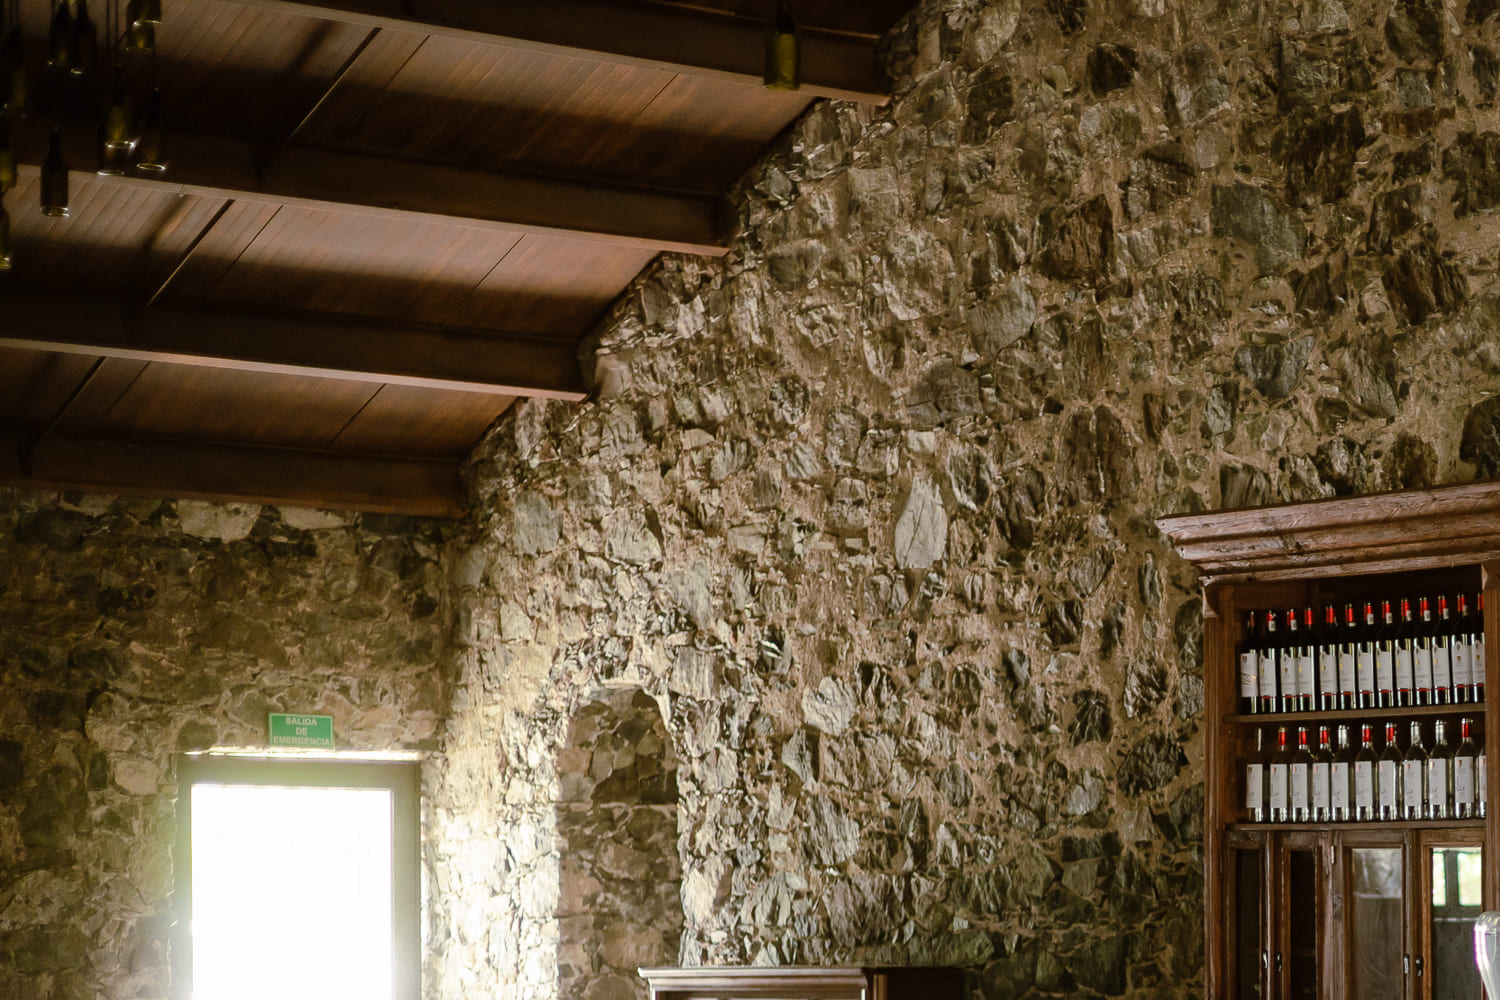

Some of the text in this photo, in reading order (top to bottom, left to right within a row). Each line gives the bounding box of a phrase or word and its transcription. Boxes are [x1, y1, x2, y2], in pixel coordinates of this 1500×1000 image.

[286, 717, 317, 726] SALIDA
[295, 727, 308, 735] DE
[273, 736, 330, 745] EMERGENCIA
